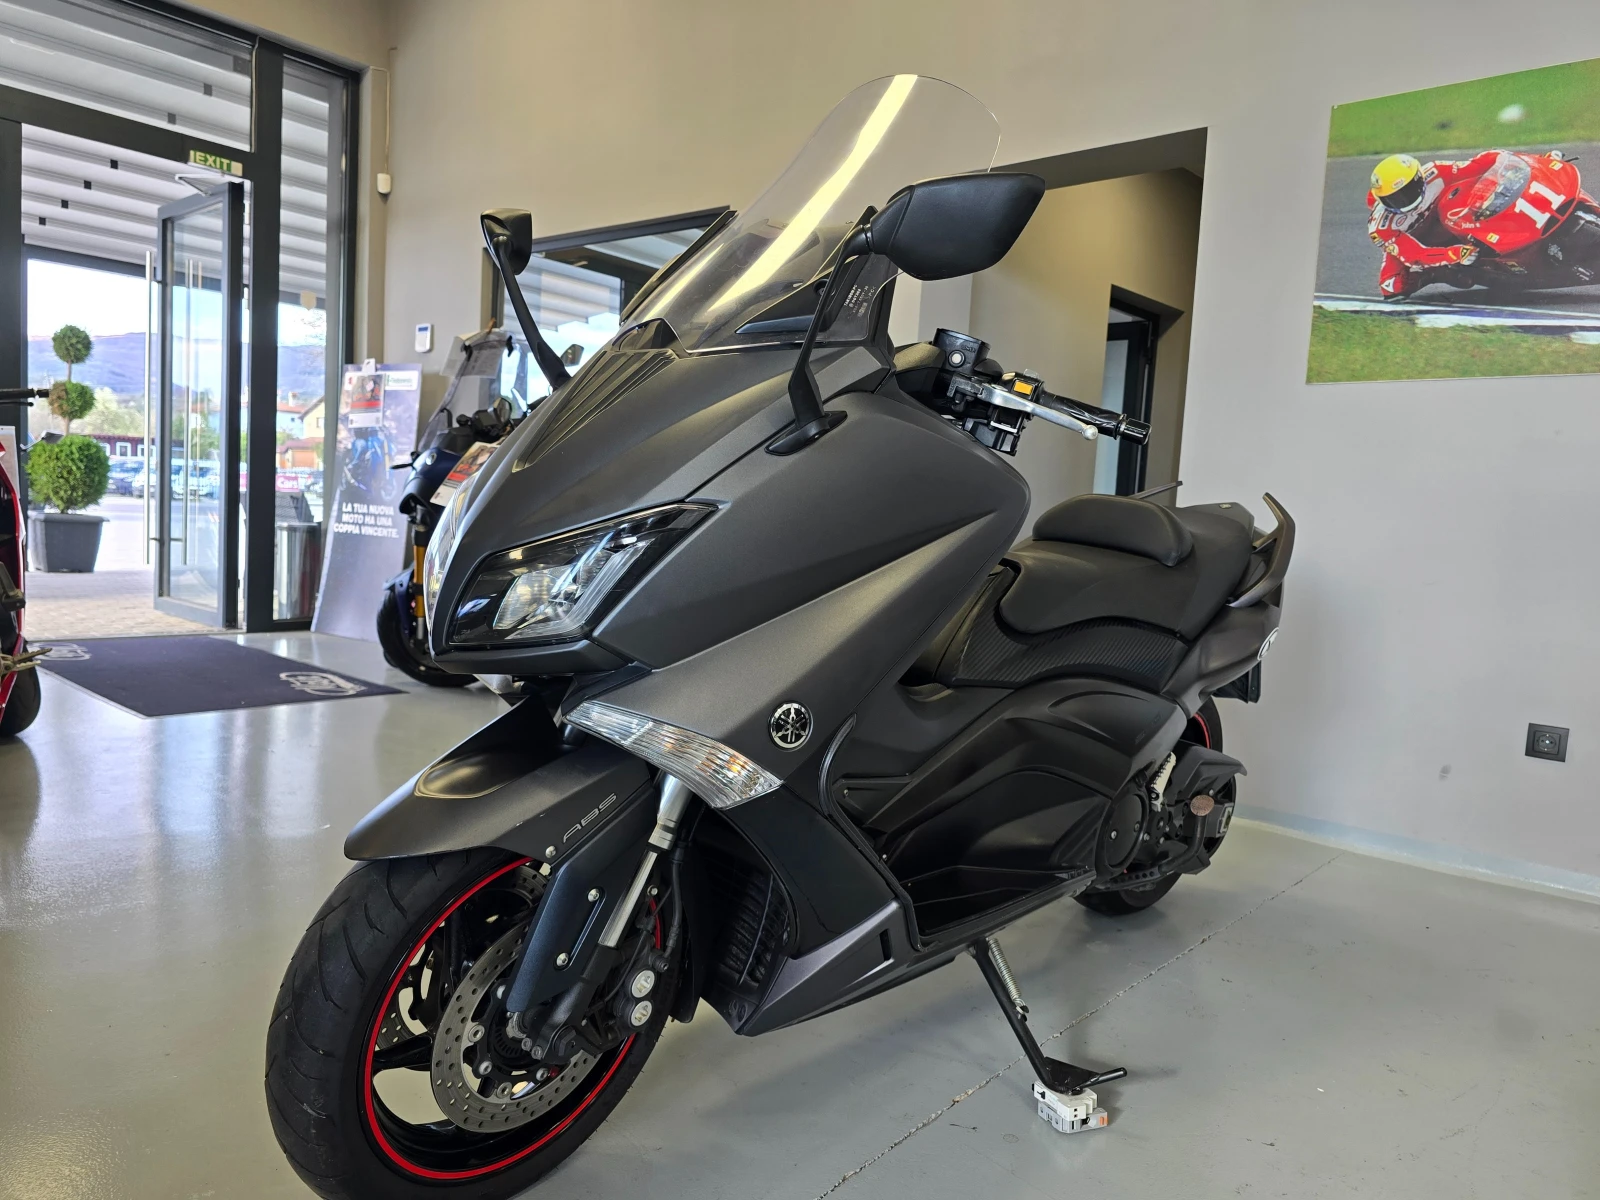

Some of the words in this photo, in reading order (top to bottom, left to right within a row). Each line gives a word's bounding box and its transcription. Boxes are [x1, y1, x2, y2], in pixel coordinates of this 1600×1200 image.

[195, 151, 231, 171] EXIT
[1514, 181, 1566, 229] 11
[342, 502, 353, 512] LA
[353, 503, 368, 514] TUA
[369, 504, 394, 516] NUOVA
[333, 523, 360, 534] COPPIA
[342, 513, 364, 524] MOTO
[364, 515, 375, 525] HA
[376, 516, 393, 527] UNA
[563, 792, 617, 843] ABS
